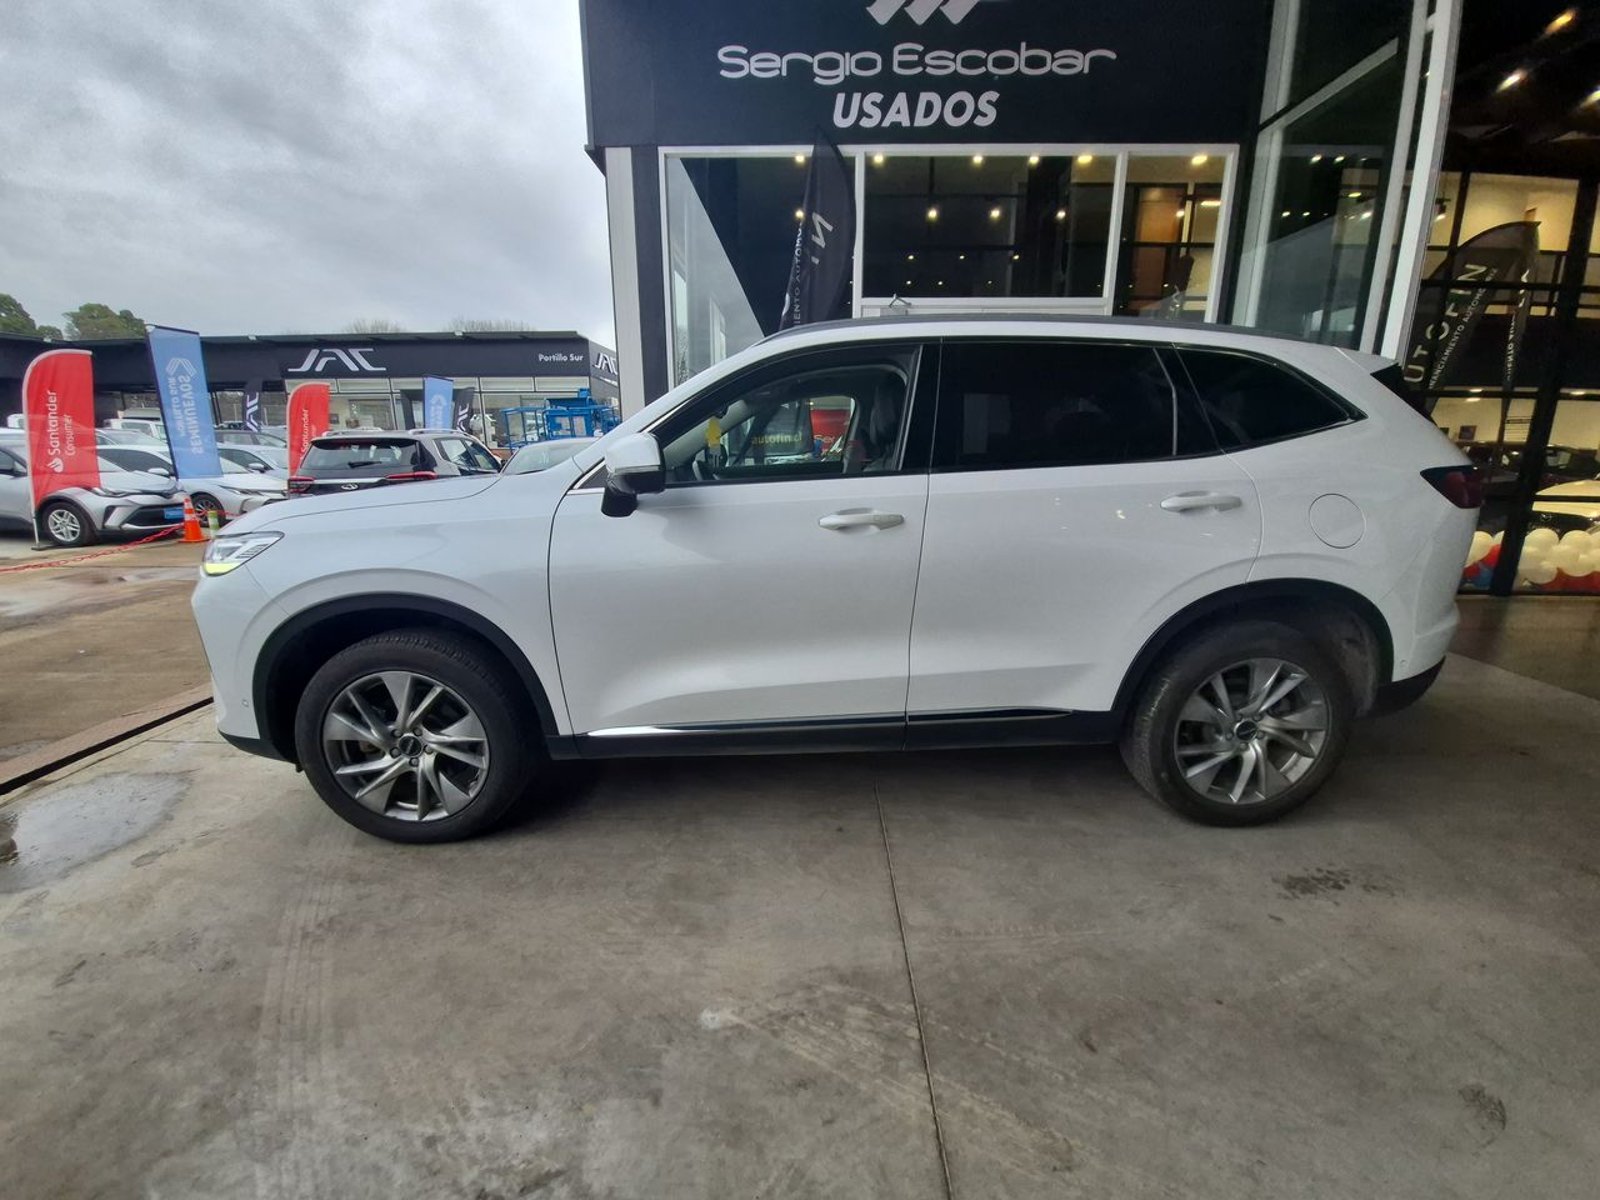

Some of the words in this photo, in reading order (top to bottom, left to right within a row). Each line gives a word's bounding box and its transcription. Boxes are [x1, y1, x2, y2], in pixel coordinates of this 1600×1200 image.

[717, 45, 882, 86] Sergio
[893, 42, 1118, 76] Escobar
[832, 90, 1000, 128] USADOS
[288, 348, 386, 372] JAC
[538, 353, 568, 362] Portillo
[569, 353, 584, 361] Sur
[46, 390, 61, 456] Santander
[64, 414, 76, 456] Consumer
